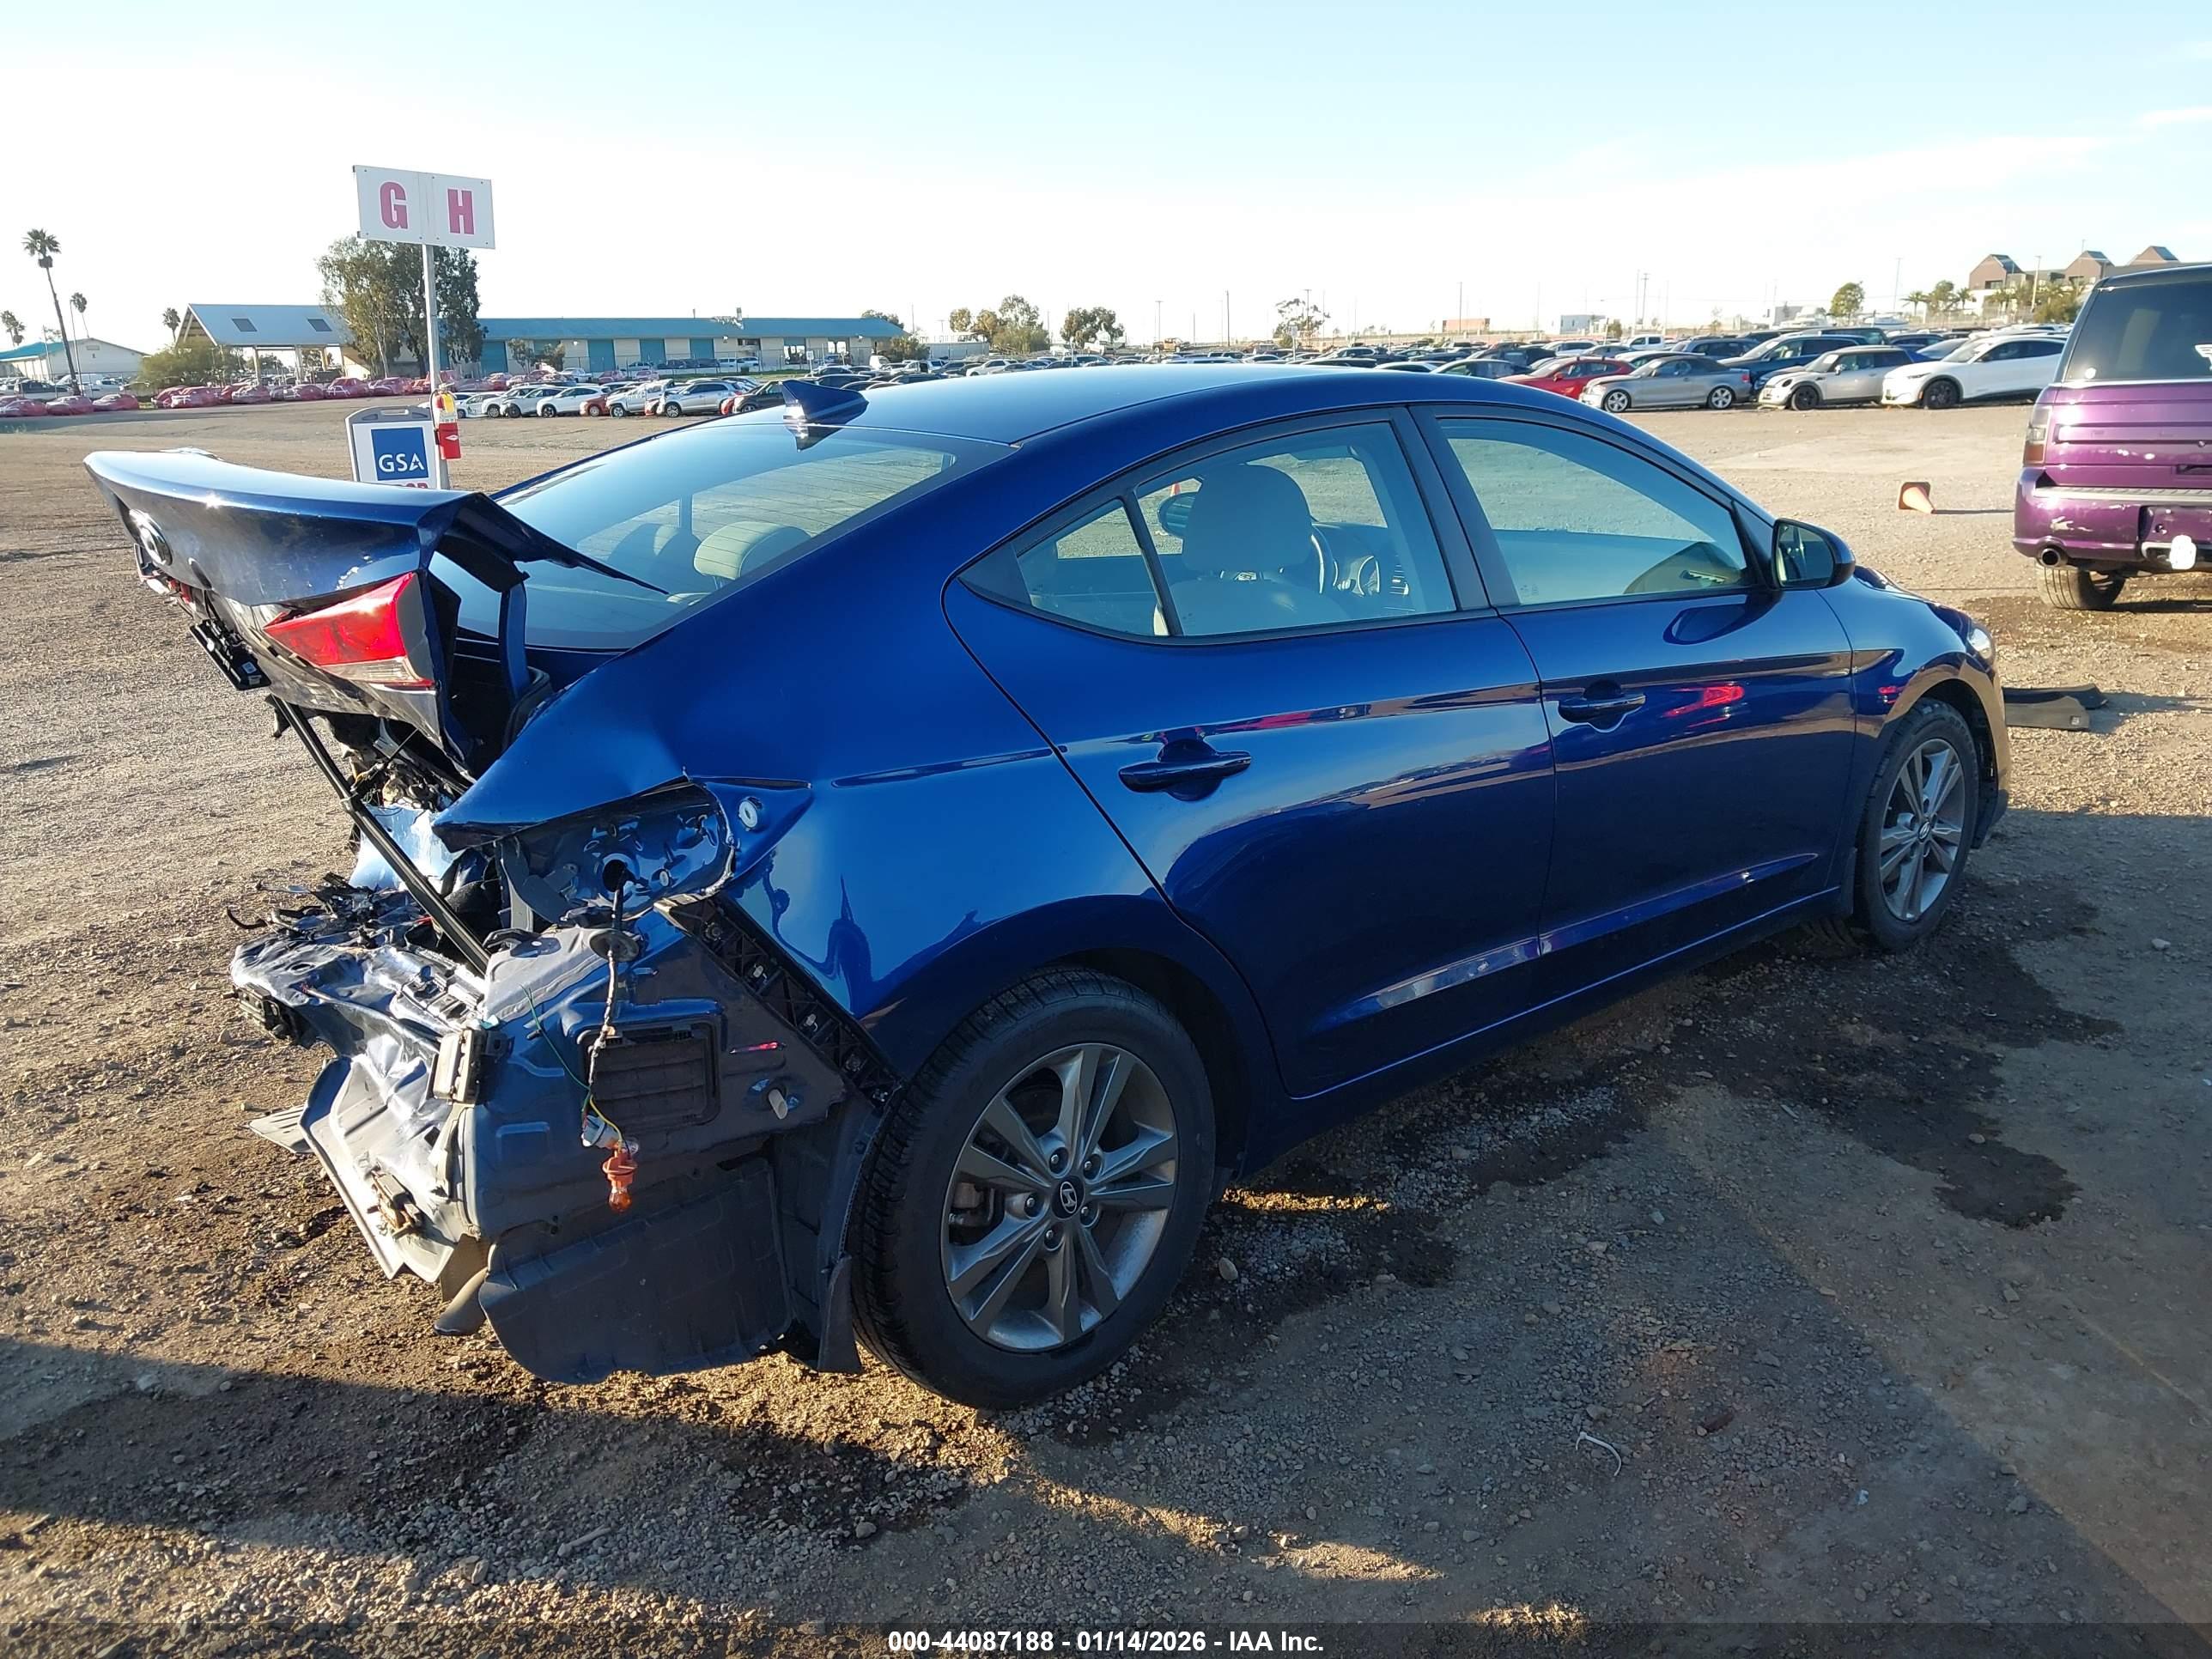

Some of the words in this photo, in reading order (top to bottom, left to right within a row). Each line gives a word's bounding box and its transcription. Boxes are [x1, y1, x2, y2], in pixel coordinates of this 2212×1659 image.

[380, 181, 409, 230] G
[447, 188, 475, 235] H
[378, 453, 425, 472] GSA
